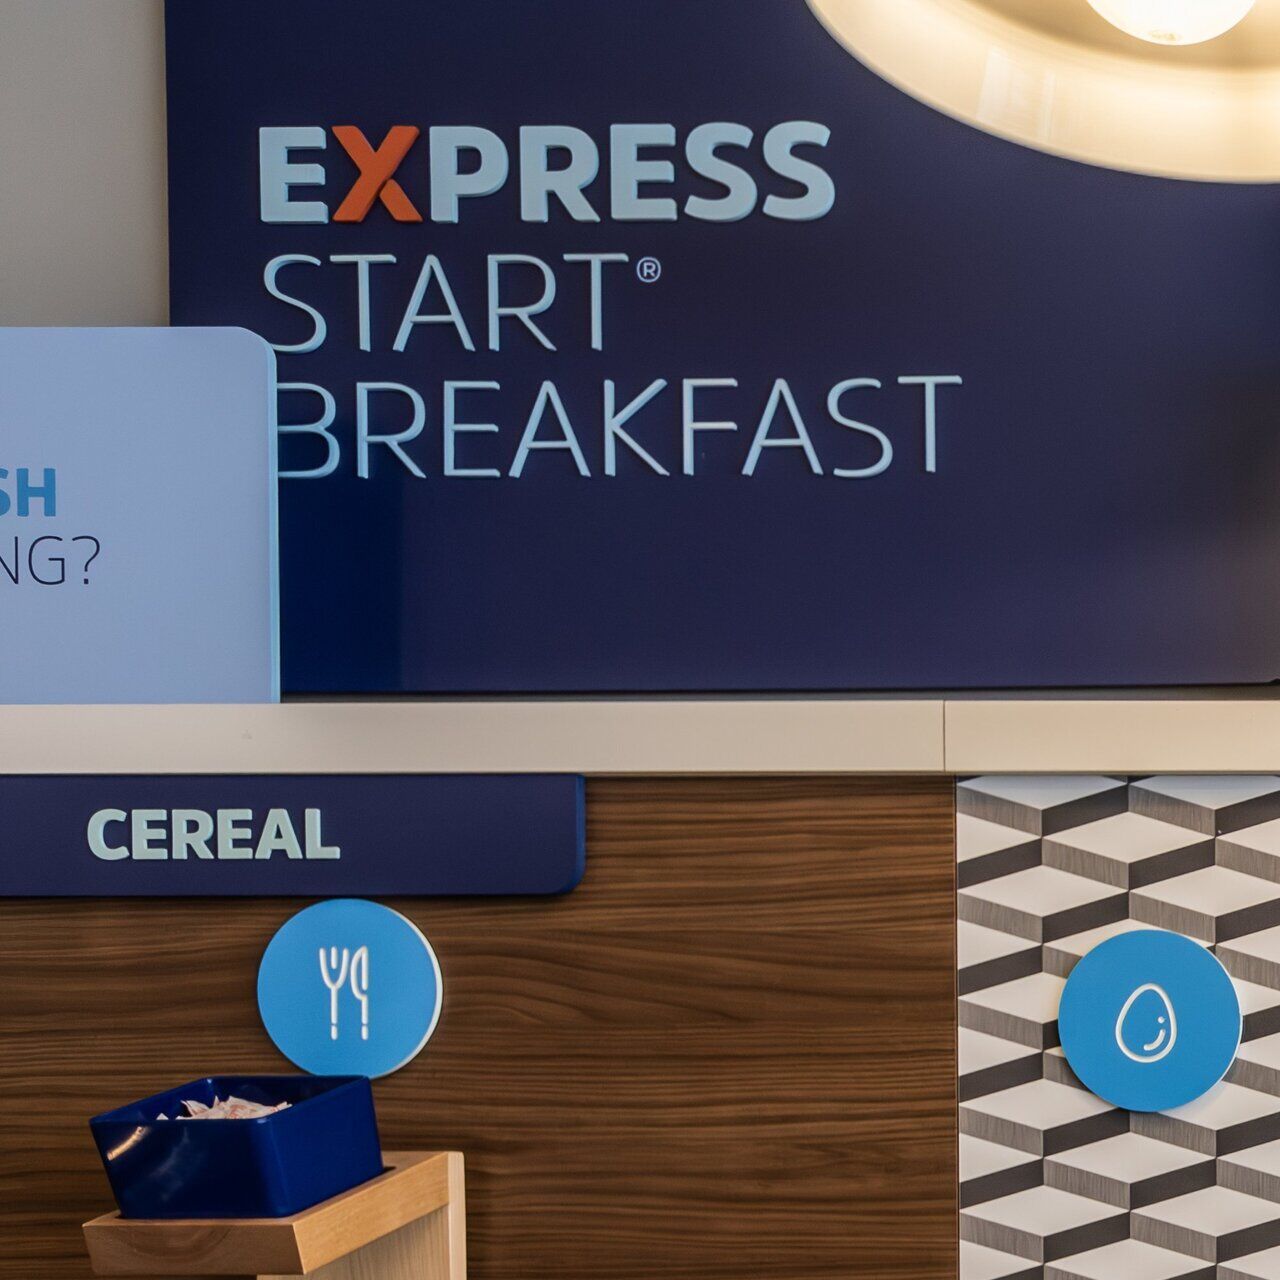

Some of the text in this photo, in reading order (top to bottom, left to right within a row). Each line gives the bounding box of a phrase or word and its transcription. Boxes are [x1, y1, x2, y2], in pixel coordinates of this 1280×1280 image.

[259, 120, 836, 224] EXPRESS
[278, 375, 962, 479] BREAKFAST
[87, 807, 341, 861] CEREAL
